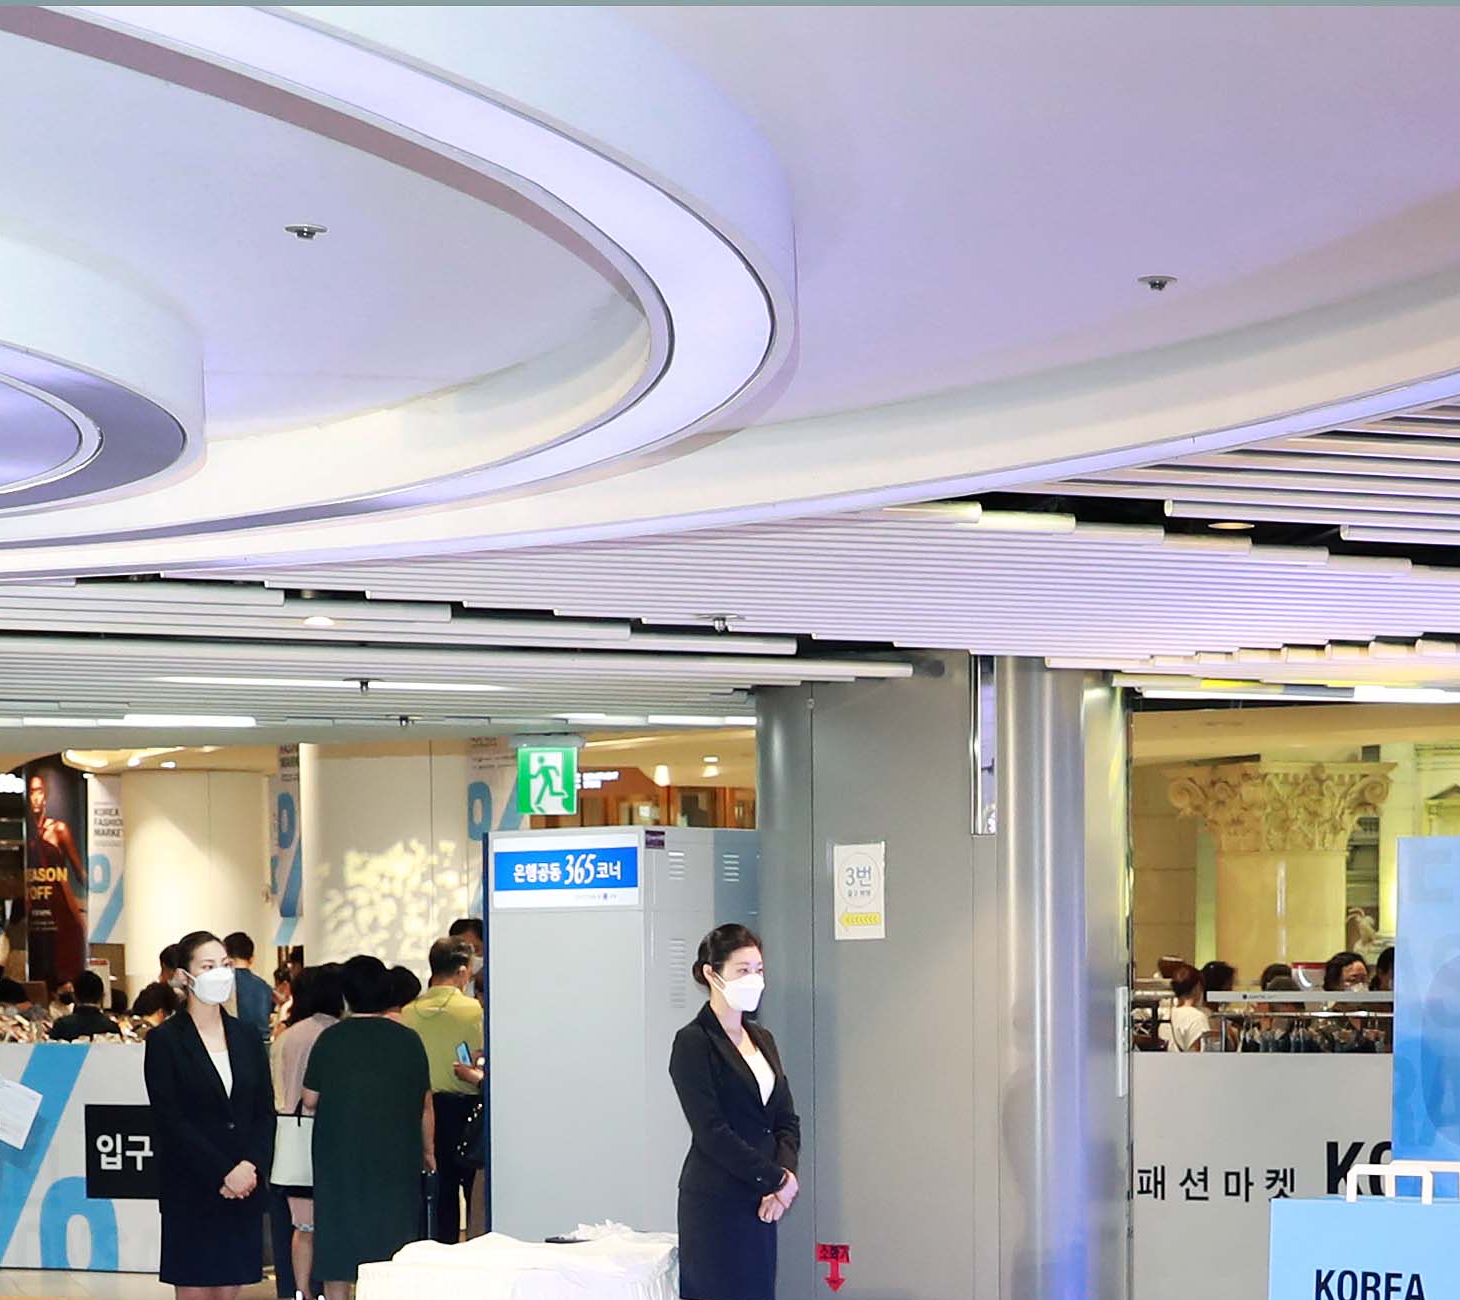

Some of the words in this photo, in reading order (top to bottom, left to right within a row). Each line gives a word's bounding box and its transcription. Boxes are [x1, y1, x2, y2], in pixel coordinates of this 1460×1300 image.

[564, 853, 597, 885] 365
[845, 864, 872, 887] 3번
[96, 1133, 154, 1171] 입구
